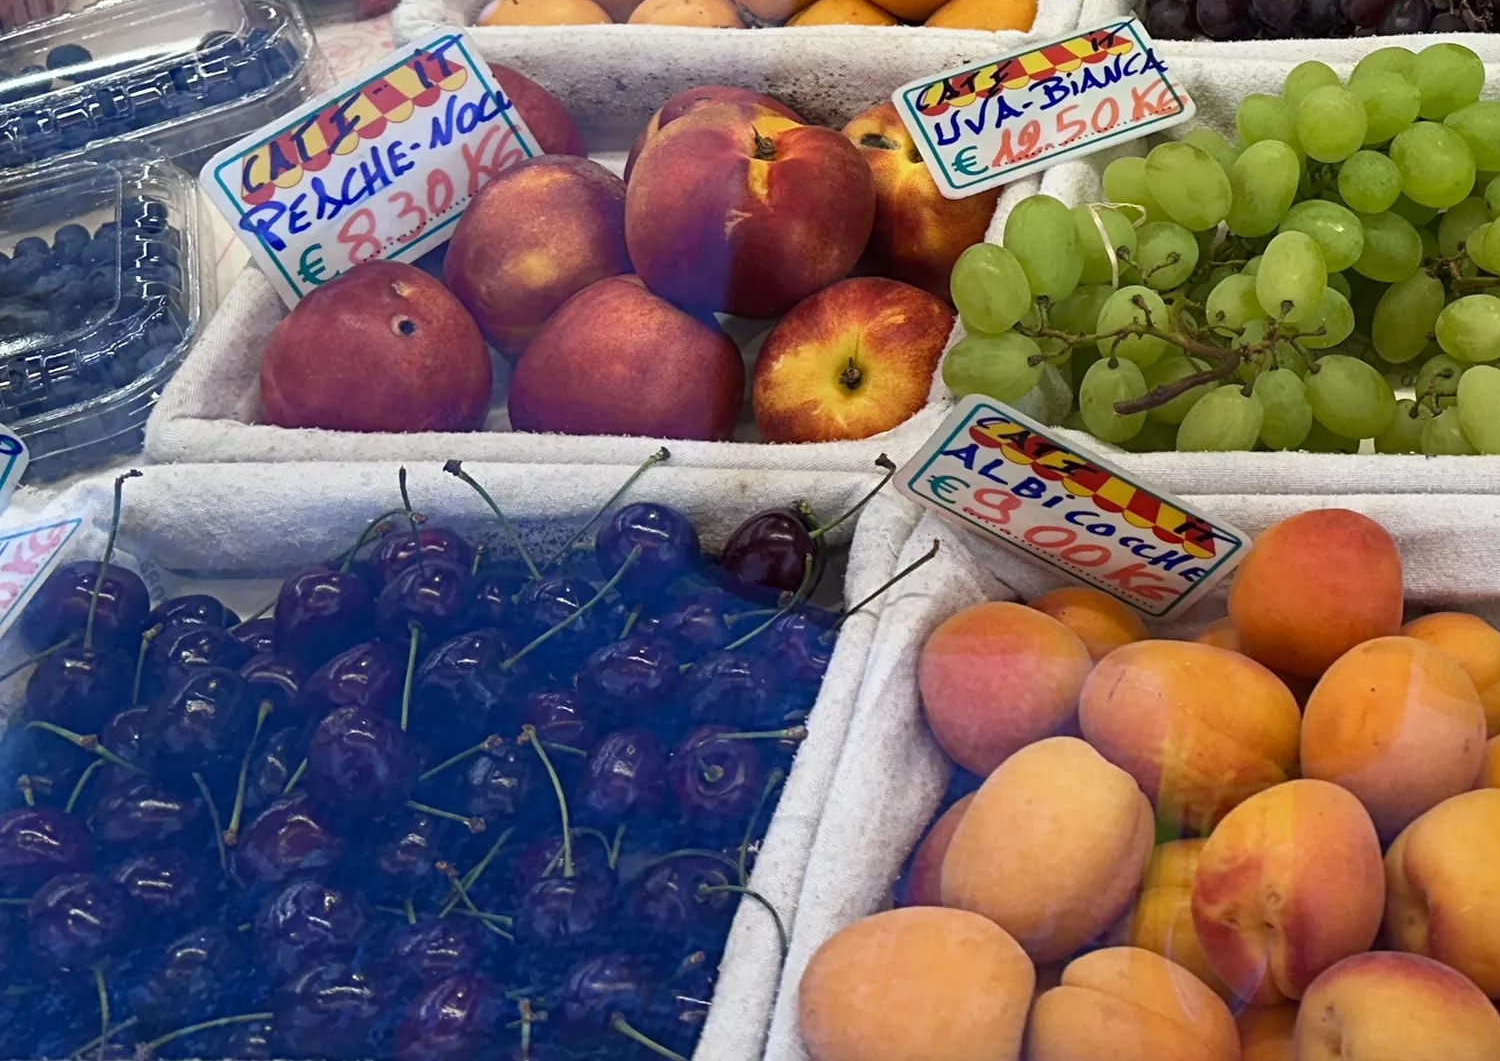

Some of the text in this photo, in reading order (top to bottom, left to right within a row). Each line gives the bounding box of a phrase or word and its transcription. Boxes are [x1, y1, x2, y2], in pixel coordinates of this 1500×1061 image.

[951, 144, 989, 177] €
[297, 243, 341, 287] €
[927, 474, 971, 505] €
